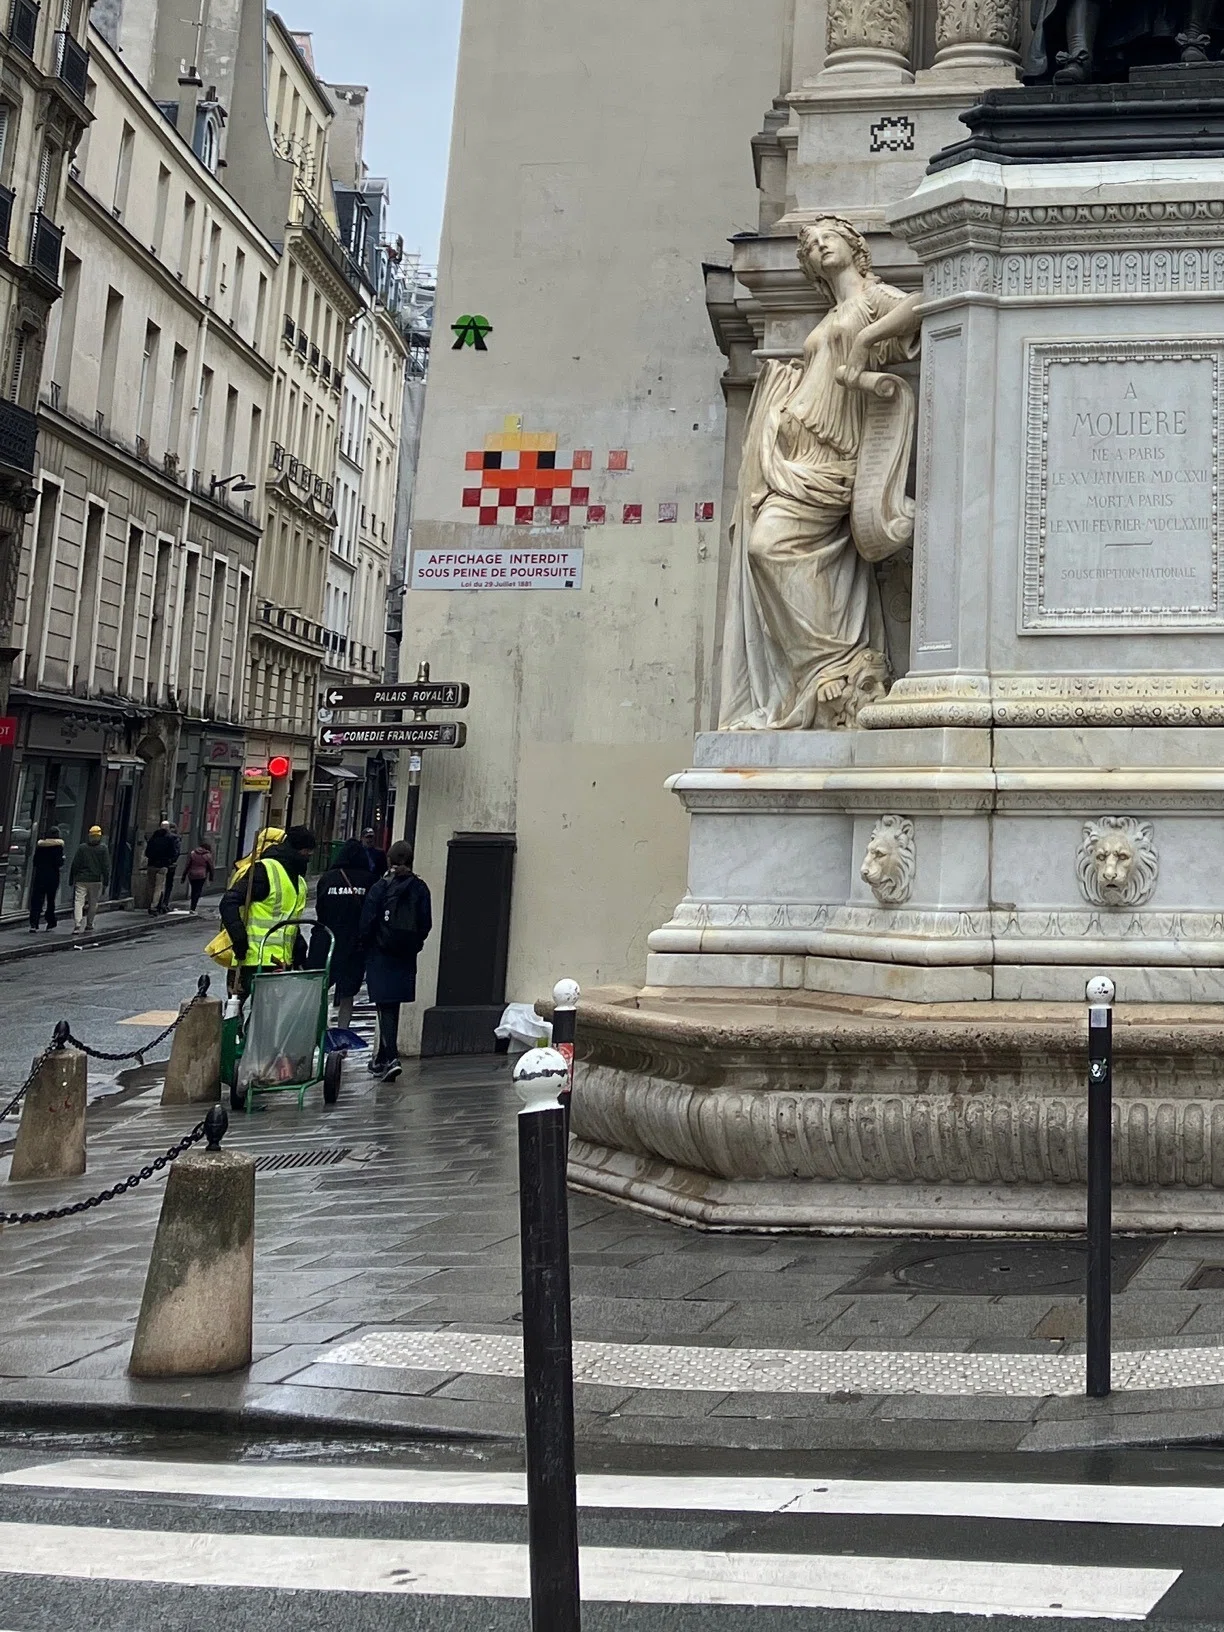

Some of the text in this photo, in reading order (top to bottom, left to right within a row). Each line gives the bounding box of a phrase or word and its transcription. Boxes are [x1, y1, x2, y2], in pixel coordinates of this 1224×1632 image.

[1124, 382, 1138, 400] A
[1128, 447, 1165, 460] PARIS
[1052, 470, 1208, 486] LE XV JANVIER MDCXXII
[1086, 494, 1123, 508] MORT
[1138, 493, 1173, 507] PARIS
[1050, 520, 1064, 533] LE
[1092, 519, 1141, 532] FEVRIER
[428, 553, 569, 565] AFFICHAGE INTERDIT
[418, 567, 577, 578] SOUS PEINE DE POURSUITE
[1061, 567, 1196, 580] SOUSCRIPTION NATIONALE
[374, 690, 442, 702] PALAIS ROYAL
[387, 730, 440, 742] FRANÇAISE
